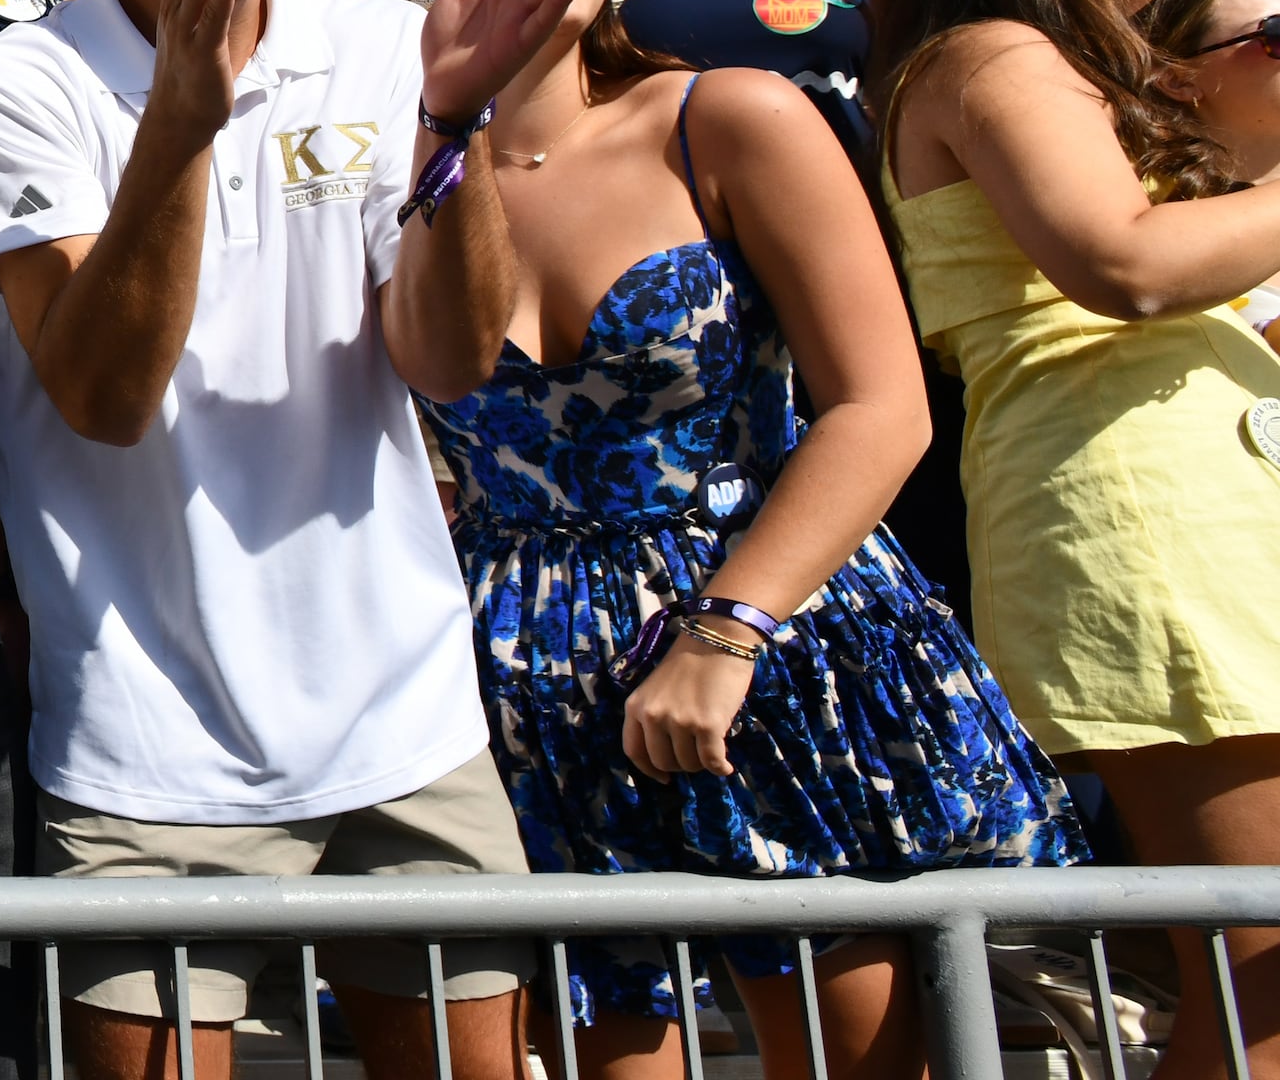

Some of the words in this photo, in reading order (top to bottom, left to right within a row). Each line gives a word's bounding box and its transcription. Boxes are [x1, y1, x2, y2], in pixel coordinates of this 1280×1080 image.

[768, 7, 809, 25] MOM
[285, 183, 354, 207] GEORGIA
[708, 477, 755, 509] ADPI
